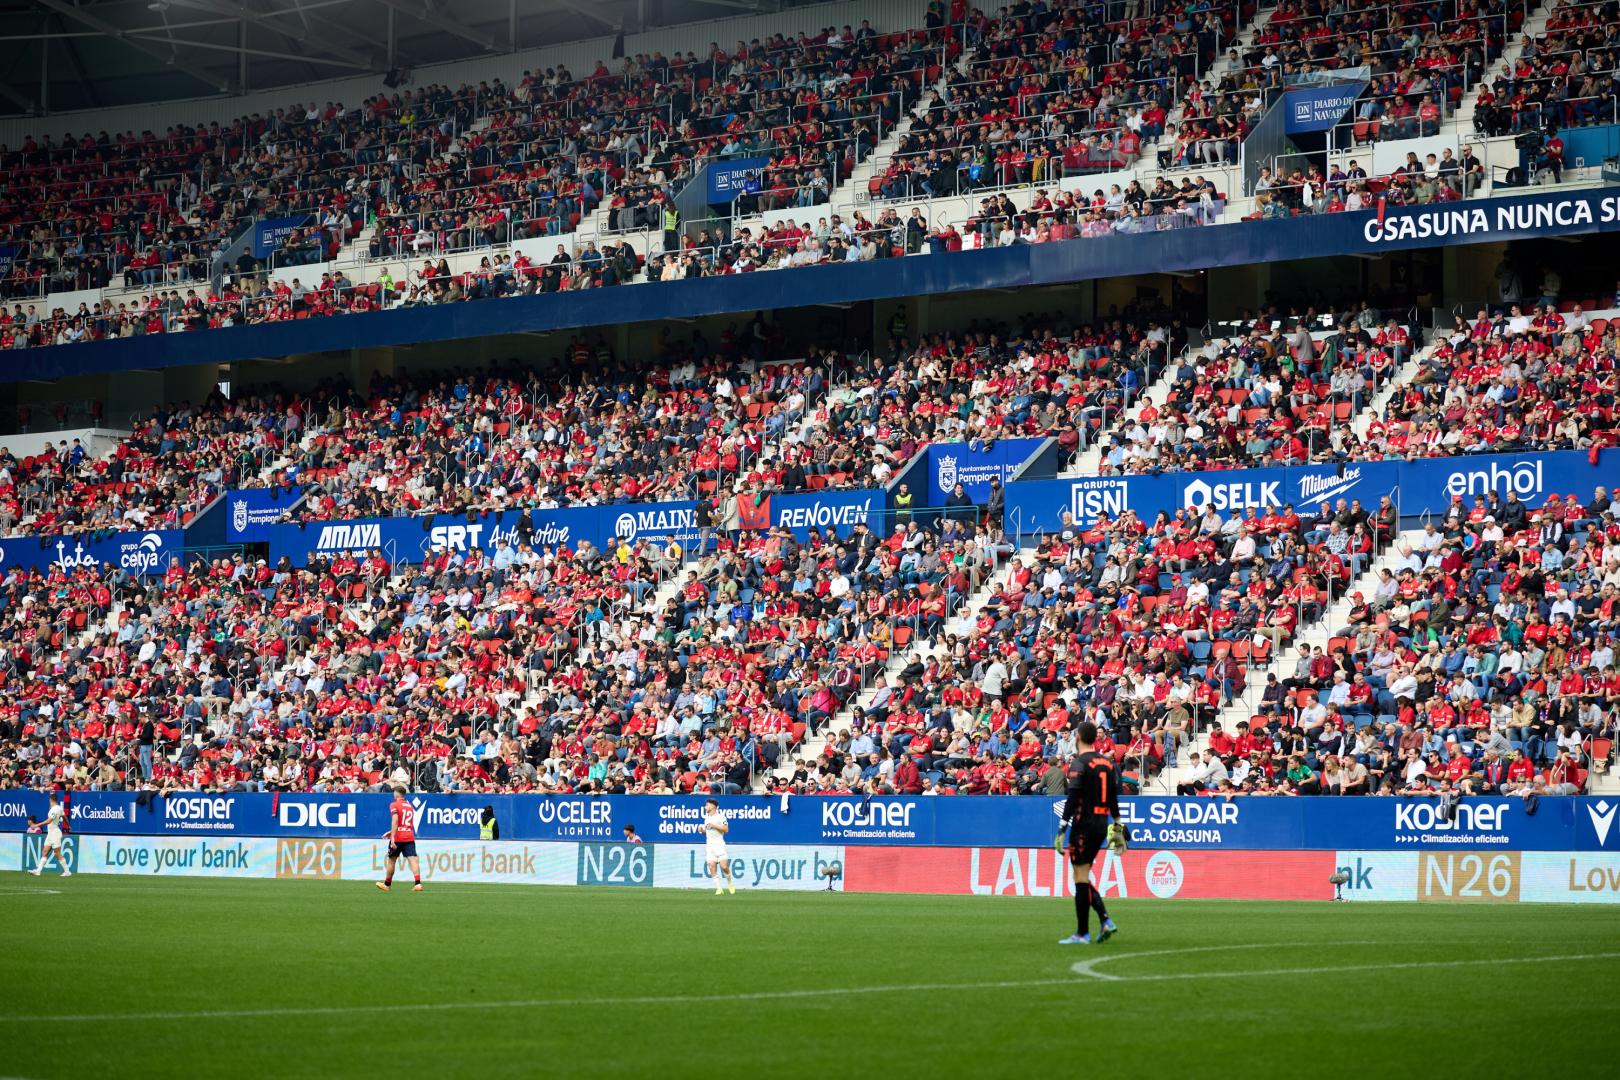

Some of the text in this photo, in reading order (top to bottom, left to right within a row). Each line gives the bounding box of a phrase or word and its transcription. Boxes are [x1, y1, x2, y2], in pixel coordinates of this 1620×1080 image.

[1297, 105, 1310, 115] DN
[1314, 98, 1342, 109] DIARIO
[718, 175, 728, 184] DN
[731, 180, 746, 189] NAV
[1364, 198, 1620, 242] OSASUNA NUNCA S
[1083, 480, 1116, 489] GRUPO
[1078, 490, 1121, 517] ISN
[780, 498, 871, 528] RENOVEN
[316, 523, 381, 549] AMAYA
[430, 524, 483, 551] SRT
[121, 543, 138, 552] grupo
[1098, 771, 1108, 803] 1
[82, 805, 125, 819] CaixaBank
[279, 803, 356, 827] DIGI
[401, 808, 414, 826] 12
[556, 801, 612, 823] CELER
[659, 804, 699, 819] Clínica
[1150, 802, 1239, 824] SADAR
[557, 827, 612, 836] LIGHTING
[658, 820, 674, 834] de
[843, 829, 916, 839] Climatización eficiente
[1131, 828, 1222, 843] C.A. OSASUNA
[1421, 833, 1510, 844] Climatización eficiente
[105, 841, 149, 866] Love
[150, 846, 196, 873] your
[201, 842, 249, 869] bank
[279, 841, 337, 876] N26
[425, 852, 475, 879] your
[481, 846, 536, 874] bank
[582, 845, 648, 883] N26
[751, 858, 807, 886] your
[1151, 877, 1178, 886] SPORTS
[1425, 854, 1513, 897] N26
